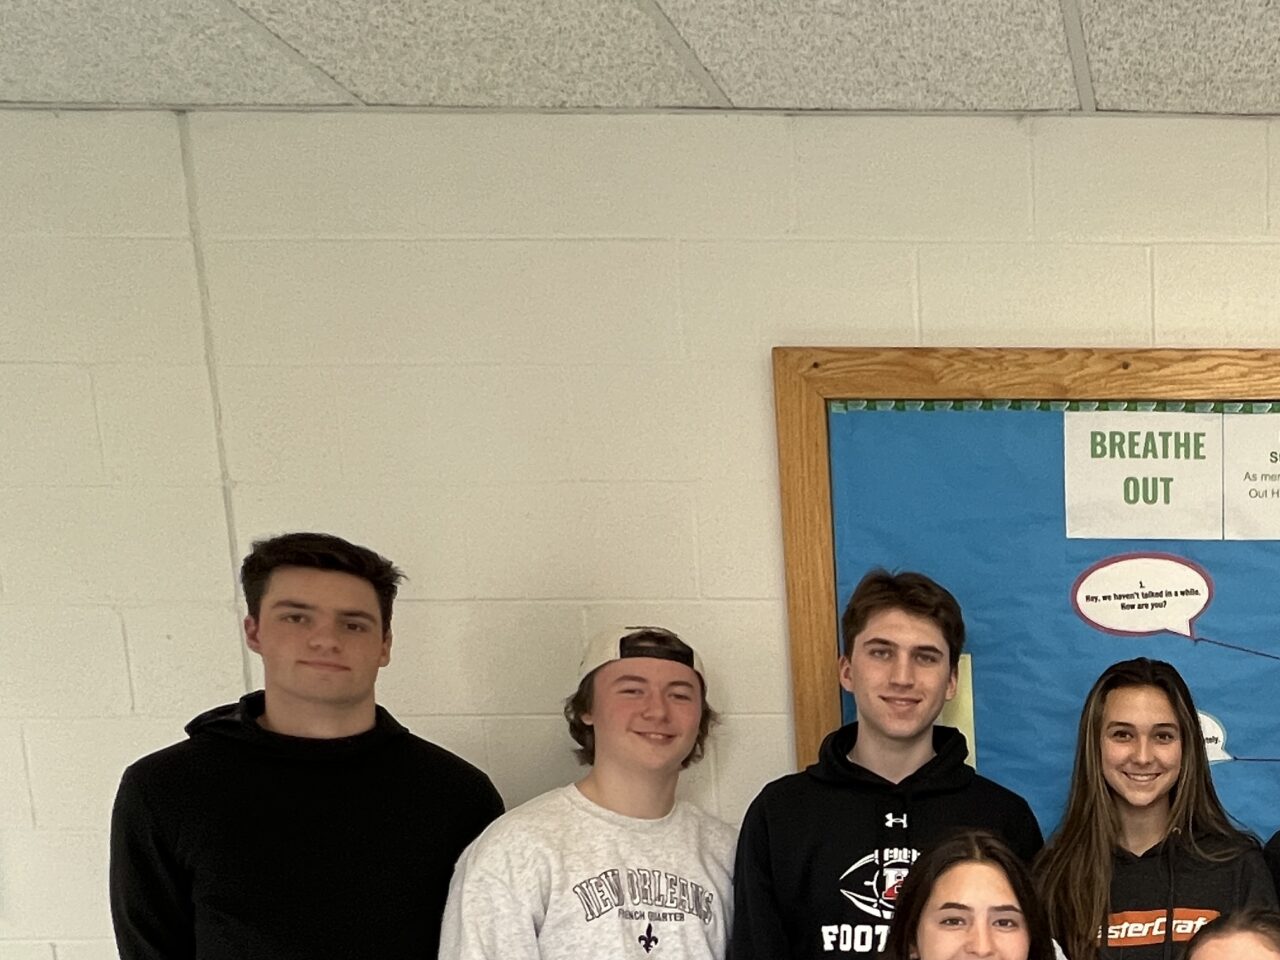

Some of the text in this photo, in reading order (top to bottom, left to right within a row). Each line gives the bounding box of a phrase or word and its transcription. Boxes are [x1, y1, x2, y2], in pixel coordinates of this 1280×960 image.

[1090, 431, 1206, 459] BREATHE
[1243, 472, 1258, 482] As
[1124, 477, 1173, 504] OUT
[1249, 488, 1268, 499] Out
[1113, 592, 1139, 600] haven't
[1142, 590, 1163, 598] talked
[1151, 601, 1167, 610] you?
[573, 868, 713, 925] NEW ORLEANS
[618, 909, 684, 921] FRENCH QUARTER
[1097, 917, 1209, 939] sterCraf
[821, 924, 890, 952] FOOT
